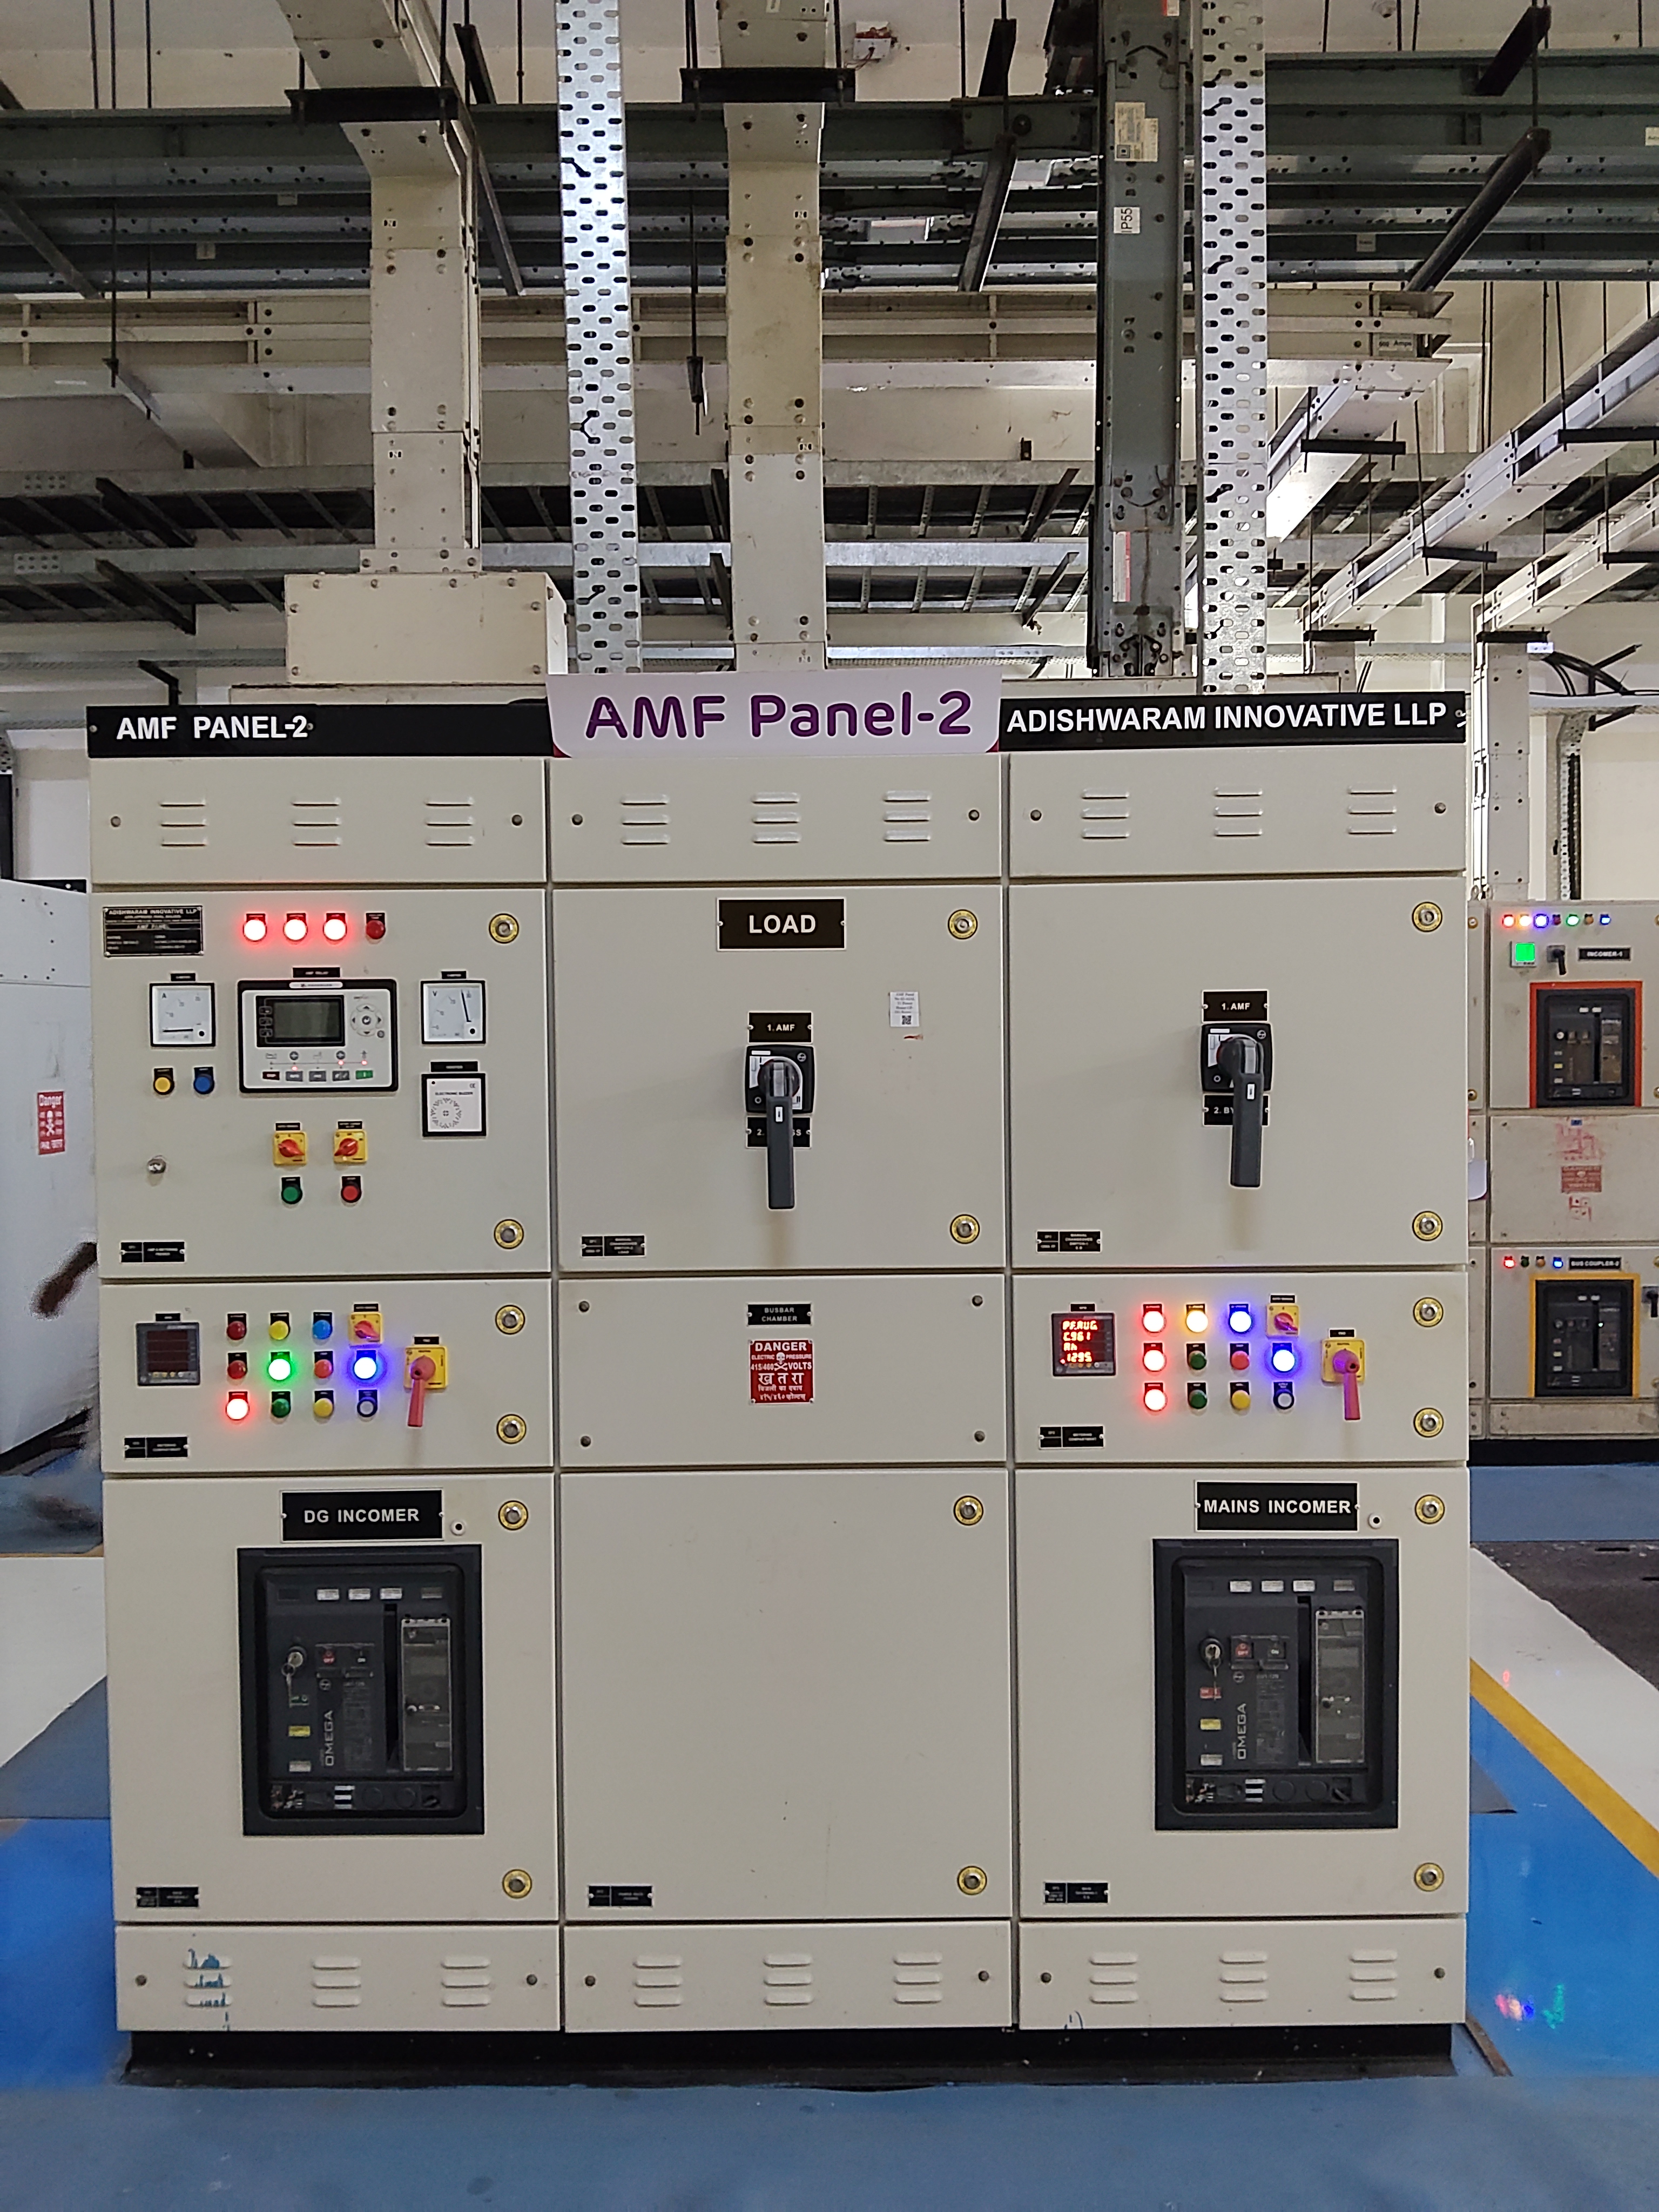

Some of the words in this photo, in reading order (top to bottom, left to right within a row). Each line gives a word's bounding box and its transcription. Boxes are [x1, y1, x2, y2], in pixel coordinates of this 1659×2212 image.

[1121, 208, 1132, 233] IP55
[585, 696, 725, 739] AMF
[750, 690, 972, 738] Panel-2
[1007, 706, 1205, 733] ADISHWARAM
[1215, 704, 1385, 729] INNOVATIVE
[1394, 703, 1447, 726] LLP
[116, 717, 177, 739] AMF
[193, 715, 308, 739] PANEL-2
[749, 914, 816, 934] LOAD
[755, 1342, 807, 1352] DANGER
[304, 1509, 329, 1523] DG
[338, 1508, 420, 1523] INCOMER
[1204, 1499, 1259, 1513] MAINS
[1269, 1500, 1351, 1514] INCOMER
[324, 1710, 334, 1766] OMEGA
[1237, 1703, 1247, 1760] OMEGA
